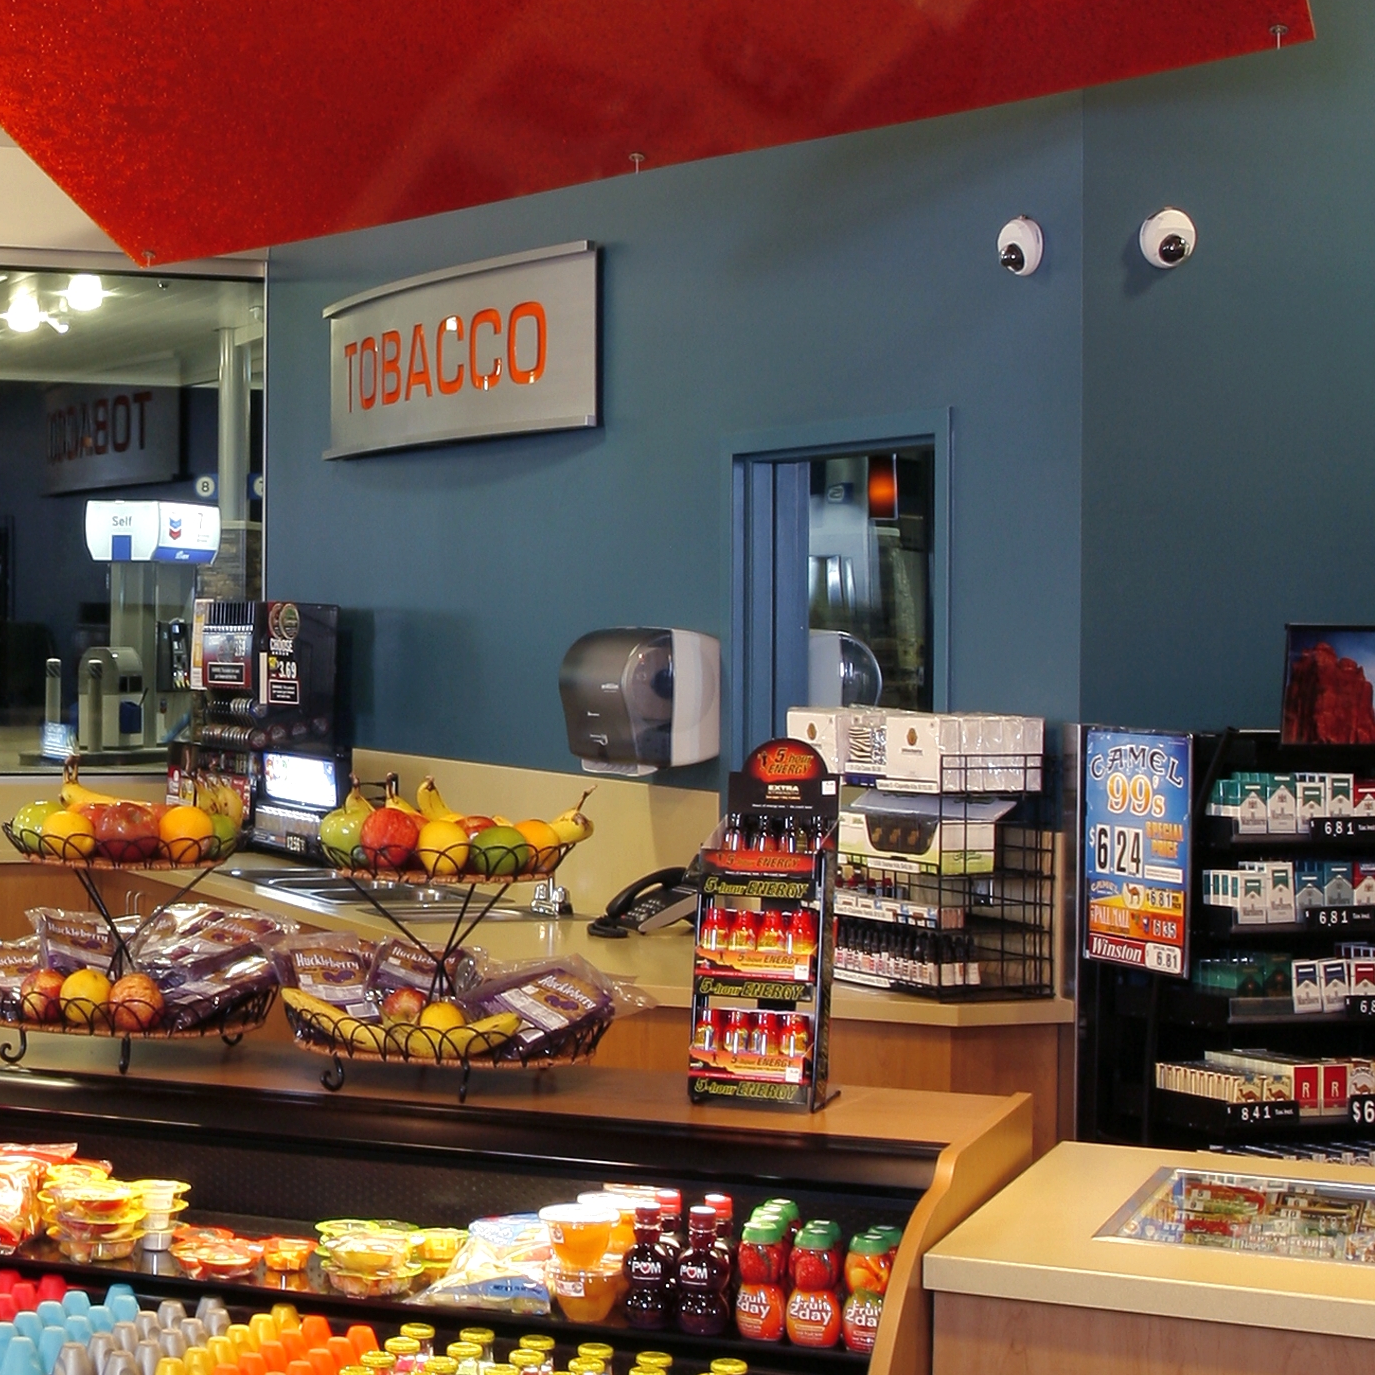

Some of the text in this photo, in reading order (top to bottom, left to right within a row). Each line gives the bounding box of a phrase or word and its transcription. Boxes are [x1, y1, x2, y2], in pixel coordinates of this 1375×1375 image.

[344, 300, 548, 413] TOBACCO
[201, 481, 210, 493] 8
[112, 515, 133, 527] Self
[768, 763, 810, 777] ENERGY
[1090, 744, 1184, 788] CAMEL
[768, 784, 800, 792] EXTRA
[1106, 772, 1165, 818] 99's
[1146, 821, 1184, 842] SPECIAL
[1151, 839, 1179, 859] PRICE
[757, 856, 801, 868] ENERGY
[704, 876, 809, 899] 5-hour ENERGY
[47, 922, 109, 943] Huckleberry
[764, 955, 801, 965] ENERGY
[1092, 937, 1143, 963] Winston
[295, 952, 360, 971] Huckleberry
[537, 975, 596, 1011] Huckleberry
[700, 977, 805, 1000] 5-hour ENERGY
[695, 1078, 800, 1100] 5-hour ENERGY
[1241, 1105, 1271, 1123] 8.41
[631, 1260, 661, 1275] POM
[679, 1264, 708, 1280] POM
[736, 1296, 770, 1318] 2day
[739, 1289, 767, 1305] Fruit
[799, 1295, 830, 1312] Fruit
[790, 1302, 832, 1325] 2day
[845, 1307, 877, 1327] 2da
